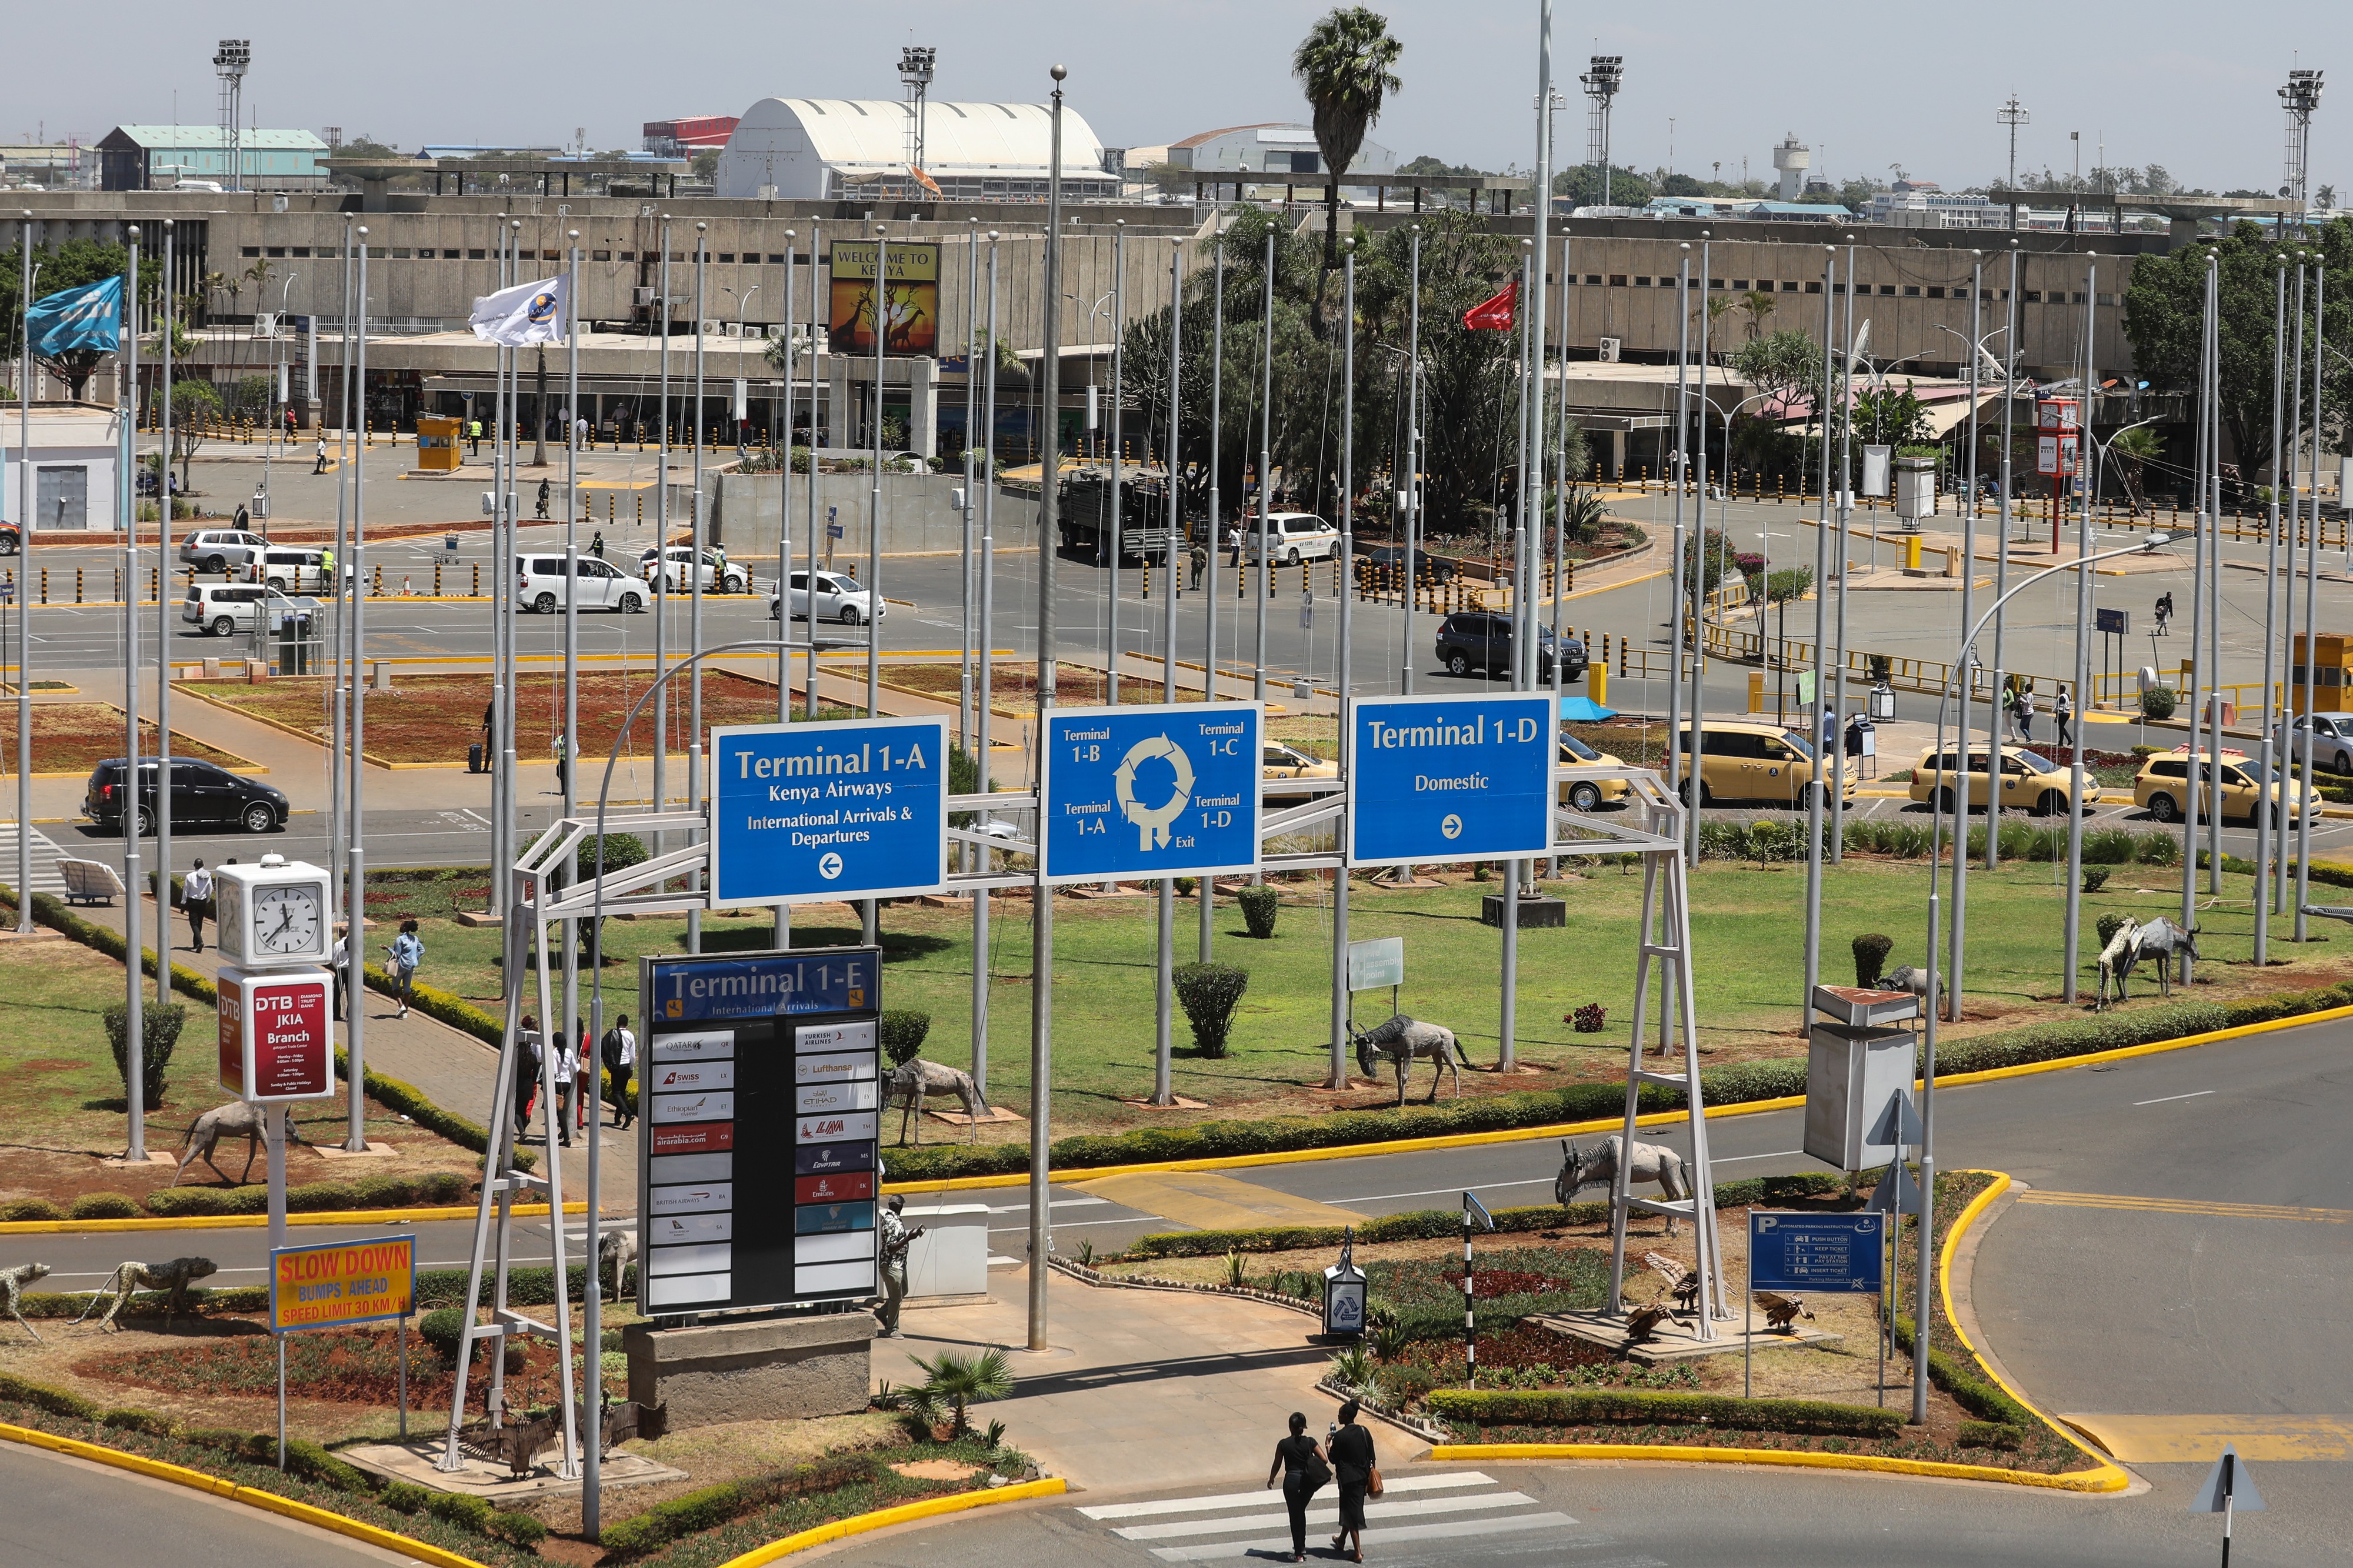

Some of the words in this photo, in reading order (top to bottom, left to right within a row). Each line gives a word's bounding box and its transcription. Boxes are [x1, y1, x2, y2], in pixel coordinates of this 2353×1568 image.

[838, 252, 905, 263] WELCME
[910, 253, 928, 264] TO
[1064, 728, 1109, 741] Terminal
[1198, 722, 1244, 735] Terminal
[1368, 715, 1484, 748] Terminal
[1494, 718, 1537, 743] 1-D
[1072, 745, 1100, 762] 1-B
[1209, 739, 1238, 756] 1-C
[735, 743, 869, 779] Terminal
[878, 743, 926, 771] 1-A
[1415, 772, 1488, 791] Domestic
[769, 785, 819, 805] Kenya
[826, 780, 892, 799] Airways
[1065, 800, 1111, 815] Terminal
[1195, 793, 1239, 808] Terminal
[748, 810, 839, 829] International
[843, 806, 896, 823] Arrivals
[901, 806, 912, 820] &
[1201, 811, 1231, 828] 1-D
[1077, 818, 1105, 835] 1-A
[792, 830, 869, 849] Departures
[1176, 835, 1195, 848] Exit
[1367, 957, 1400, 968] assembly
[669, 963, 803, 998] Terminal
[816, 962, 861, 990] 1-E
[1367, 970, 1385, 981] point
[221, 995, 240, 1021] DTB
[256, 996, 292, 1011] DTB
[713, 1002, 775, 1015] International
[778, 1002, 818, 1012] Arrivals
[276, 1013, 303, 1028] JKIA
[268, 1030, 309, 1043] Branch
[666, 1040, 692, 1051] QATAR
[812, 1063, 852, 1073] Lufthansa
[677, 1073, 699, 1081] SWISS
[657, 1137, 706, 1145] airarabia.com
[1758, 1217, 1777, 1233] P
[280, 1252, 339, 1283] SLOW
[345, 1245, 408, 1276] DOWN
[299, 1282, 341, 1302] BUMPS
[349, 1277, 388, 1296] AHEAD
[283, 1306, 319, 1323] SPEED
[323, 1302, 352, 1318] LIMIT
[355, 1300, 369, 1314] 30
[372, 1296, 405, 1313] KM/H
